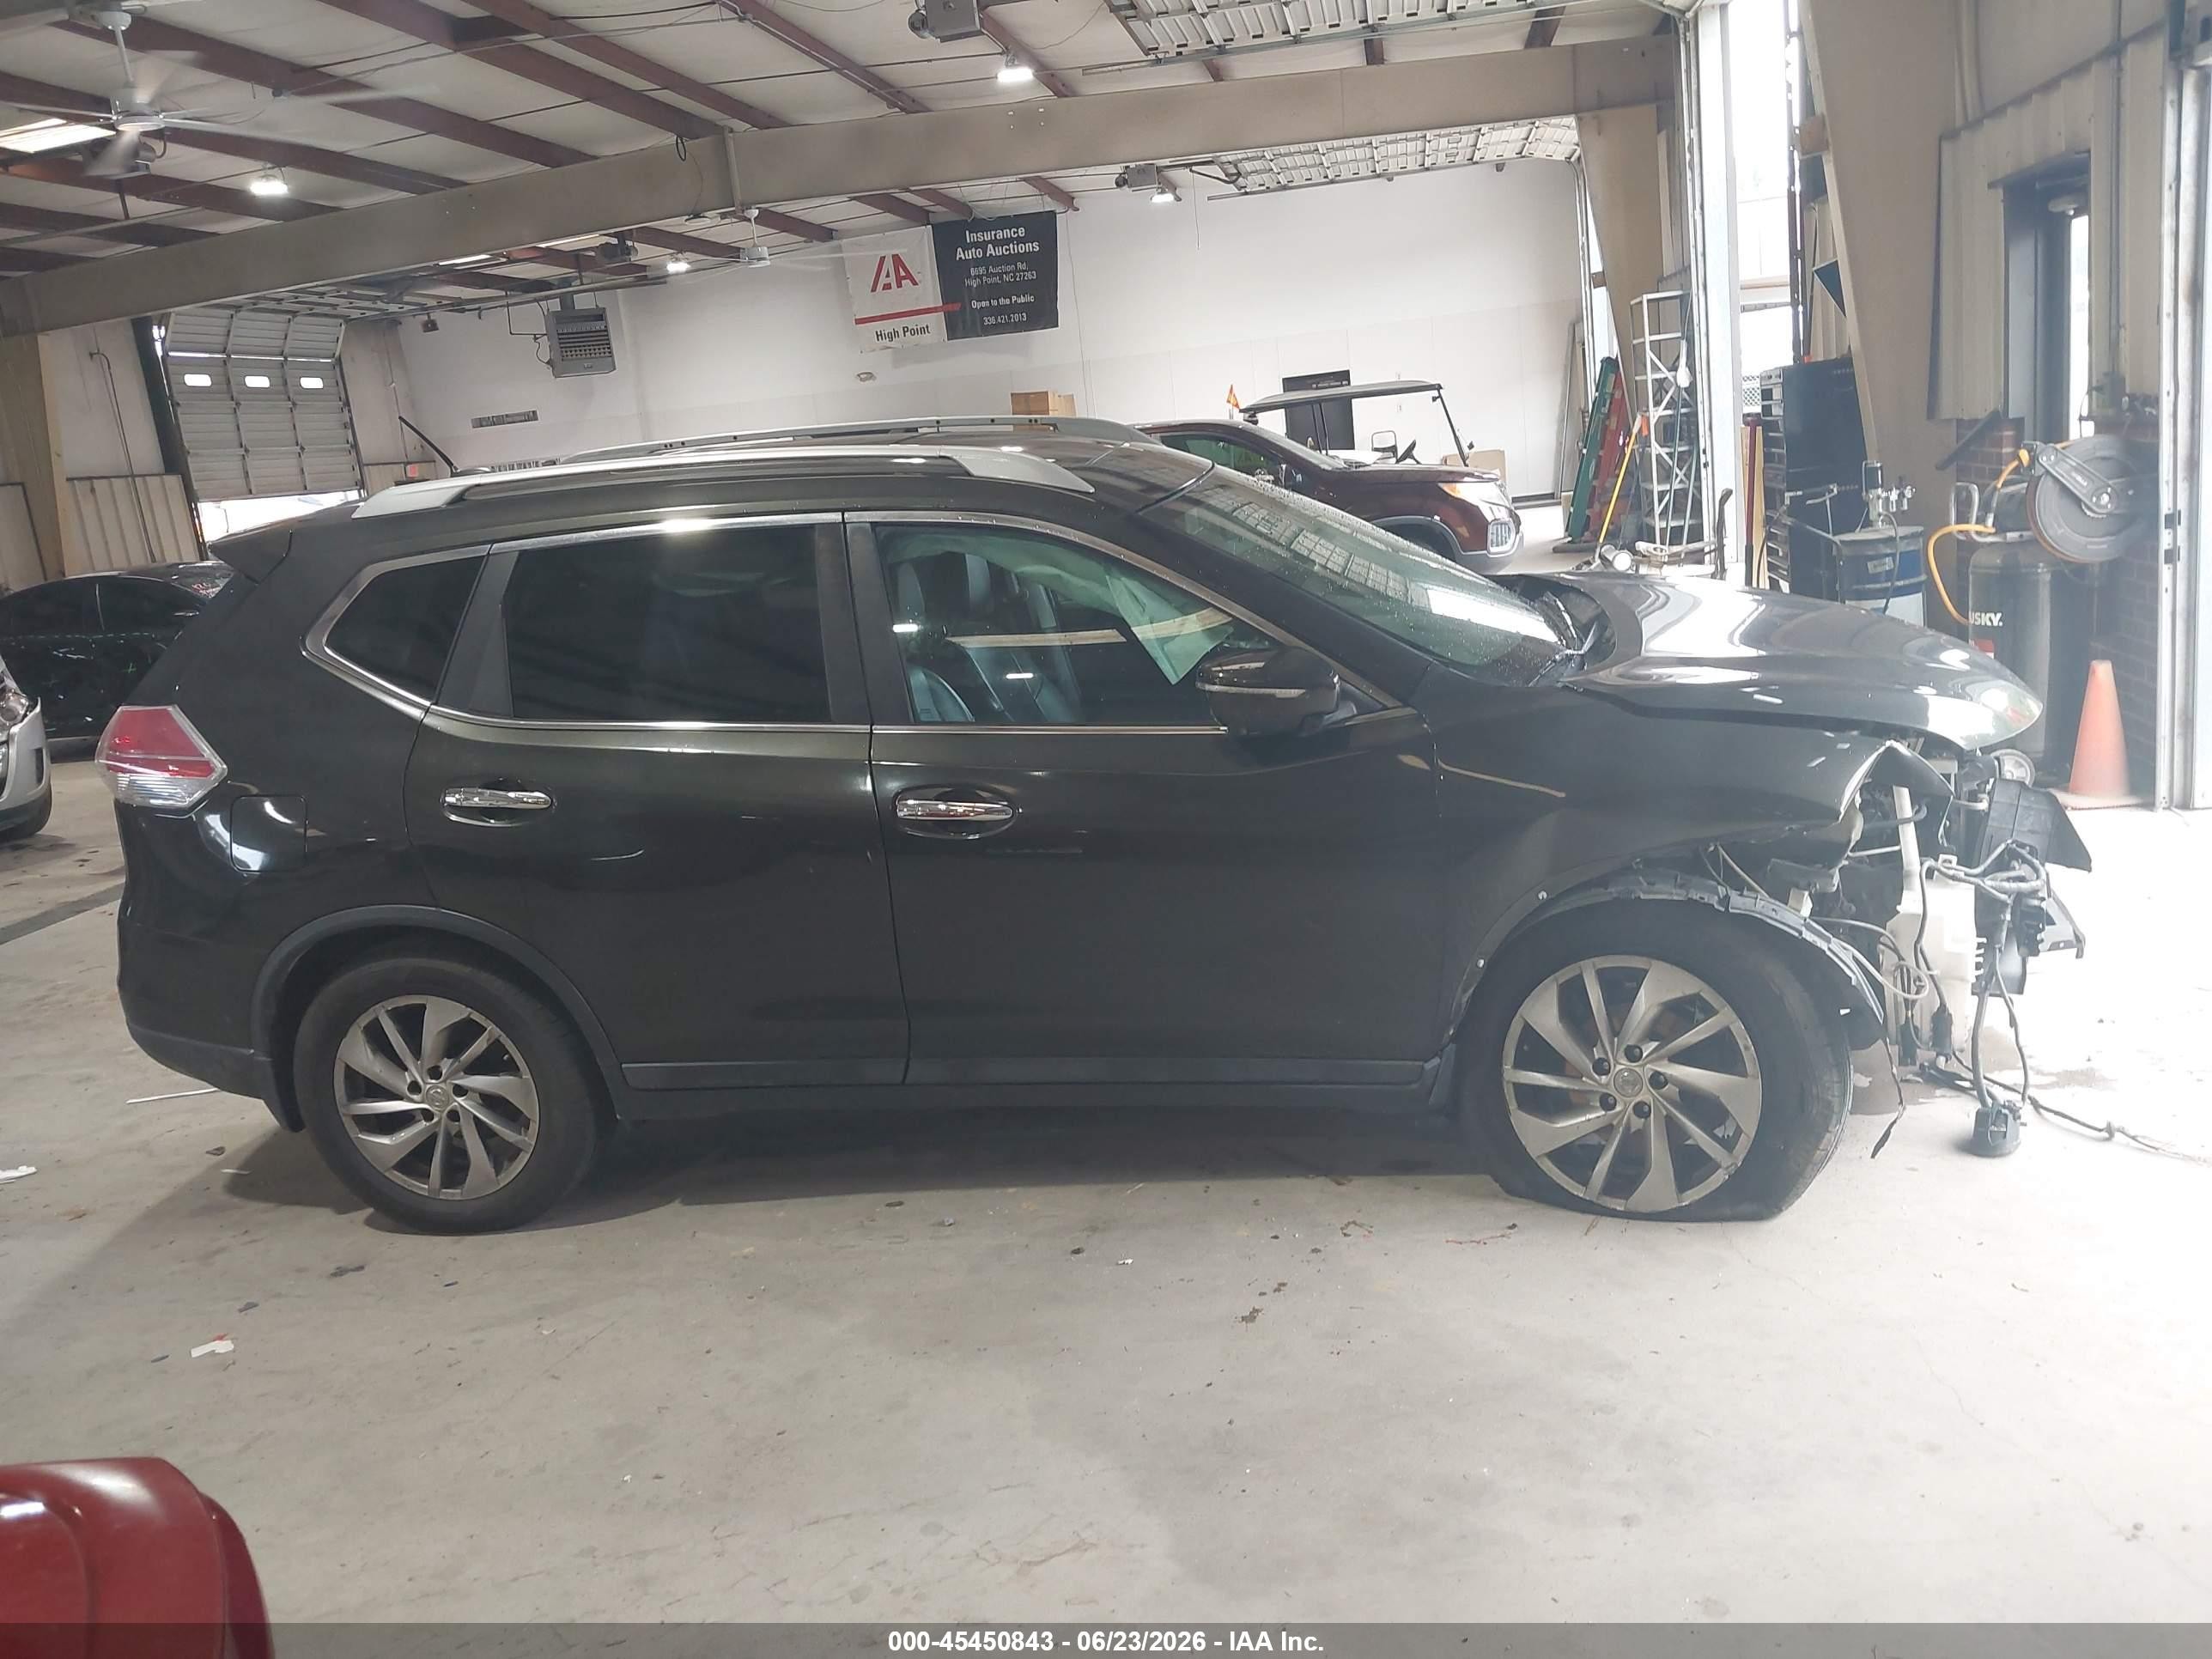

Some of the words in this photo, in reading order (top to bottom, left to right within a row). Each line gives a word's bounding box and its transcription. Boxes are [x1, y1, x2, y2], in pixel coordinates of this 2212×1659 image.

[966, 227, 1025, 243] Insurance
[956, 246, 983, 261] Auto
[986, 240, 1040, 258] Auctions
[988, 264, 1016, 274] Auction
[964, 277, 981, 288] High
[1003, 273, 1014, 283] NC
[1016, 270, 1036, 281] 27263
[971, 300, 989, 310] Open
[991, 298, 998, 307] to
[999, 296, 1011, 306] the
[1012, 294, 1035, 305] Public
[983, 313, 1027, 325] 336.421.2013
[875, 328, 900, 343] High
[902, 324, 931, 337] Point
